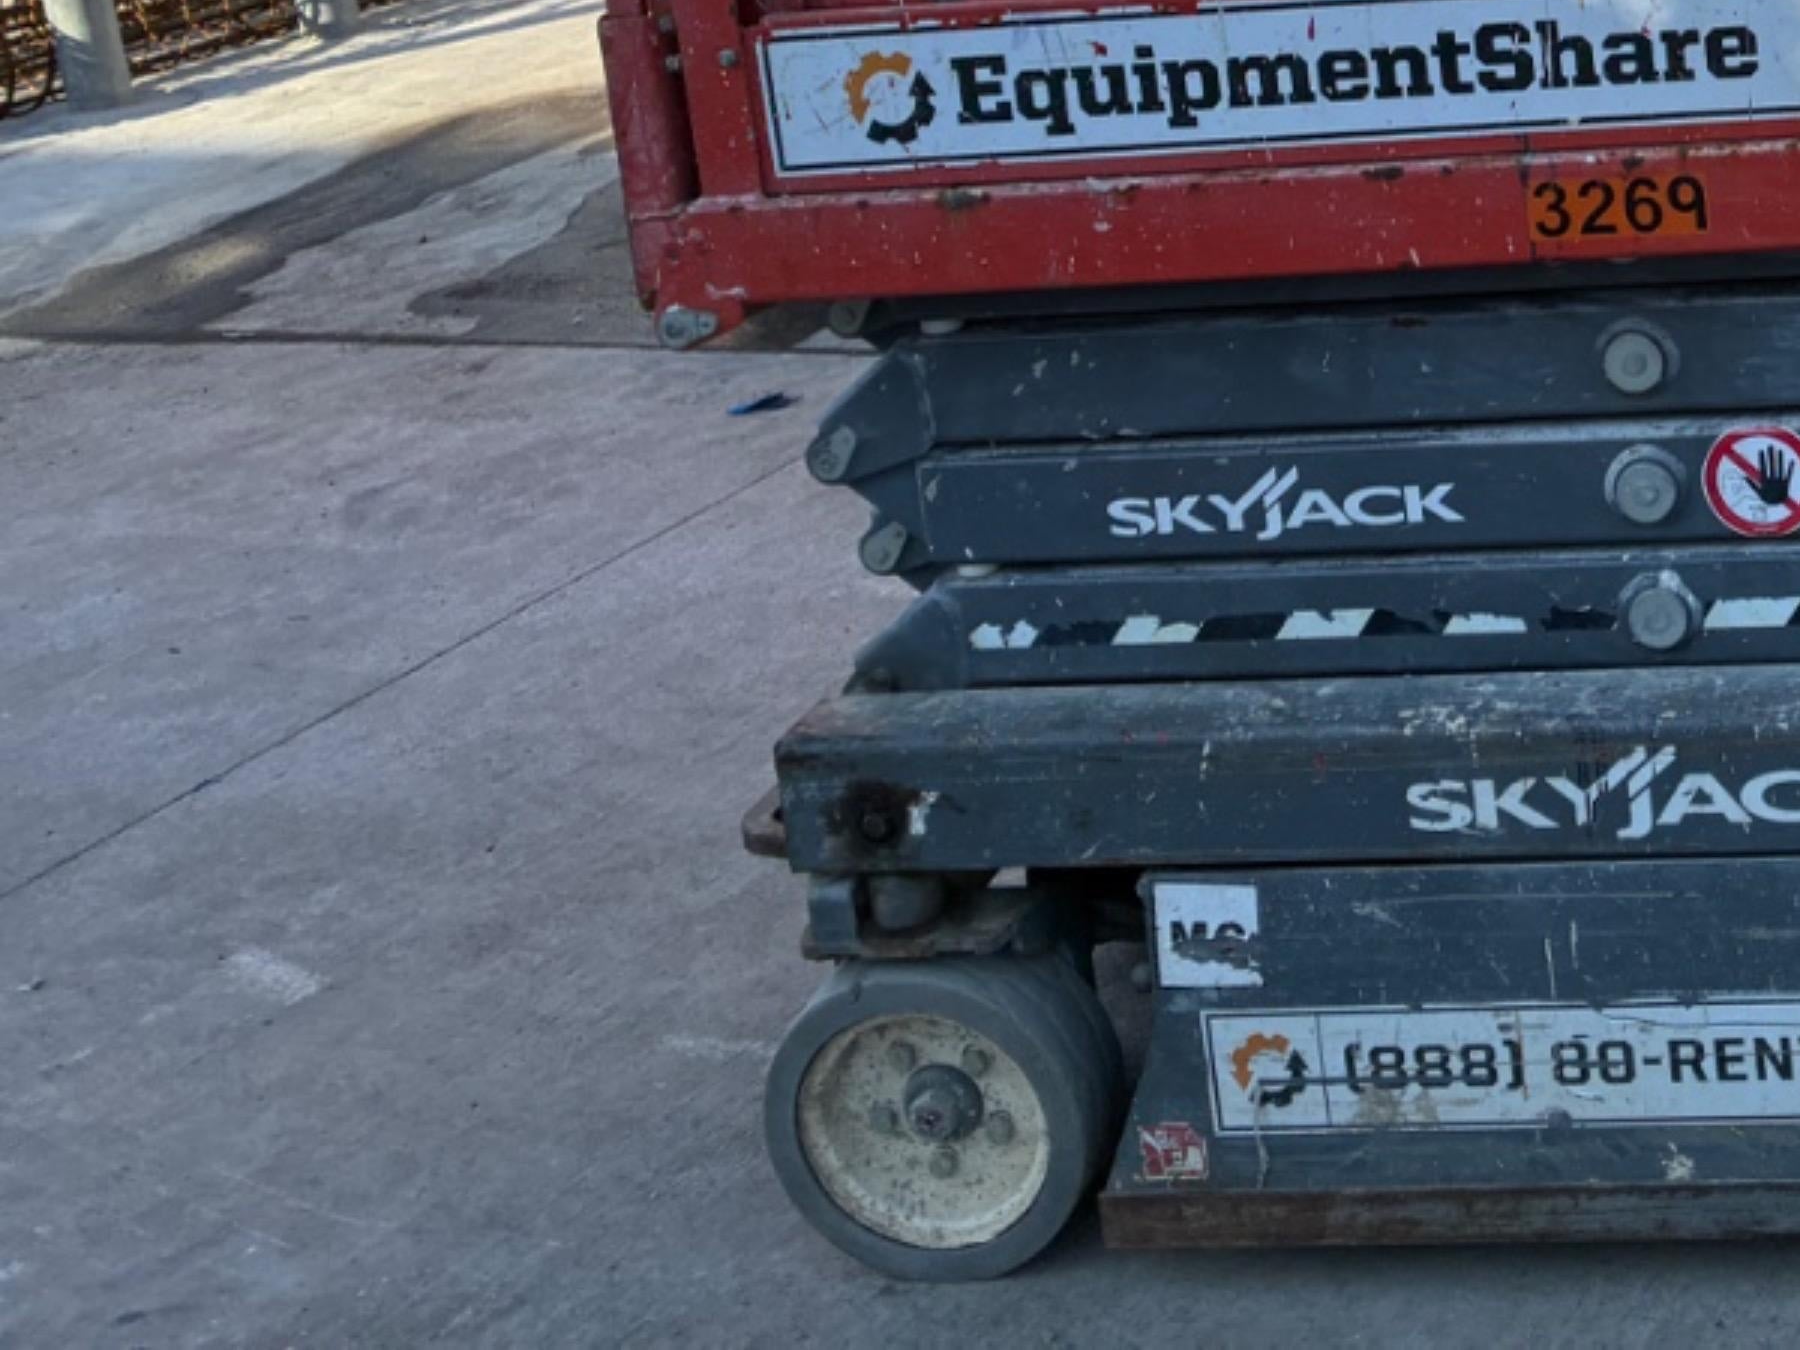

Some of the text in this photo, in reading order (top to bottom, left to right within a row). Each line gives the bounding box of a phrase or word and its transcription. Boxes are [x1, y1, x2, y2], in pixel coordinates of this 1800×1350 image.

[953, 21, 1759, 135] EquipmentShare
[1533, 175, 1707, 238] 3269
[1106, 466, 1465, 541] SKYJACK
[1344, 1038, 1526, 1092] (888)
